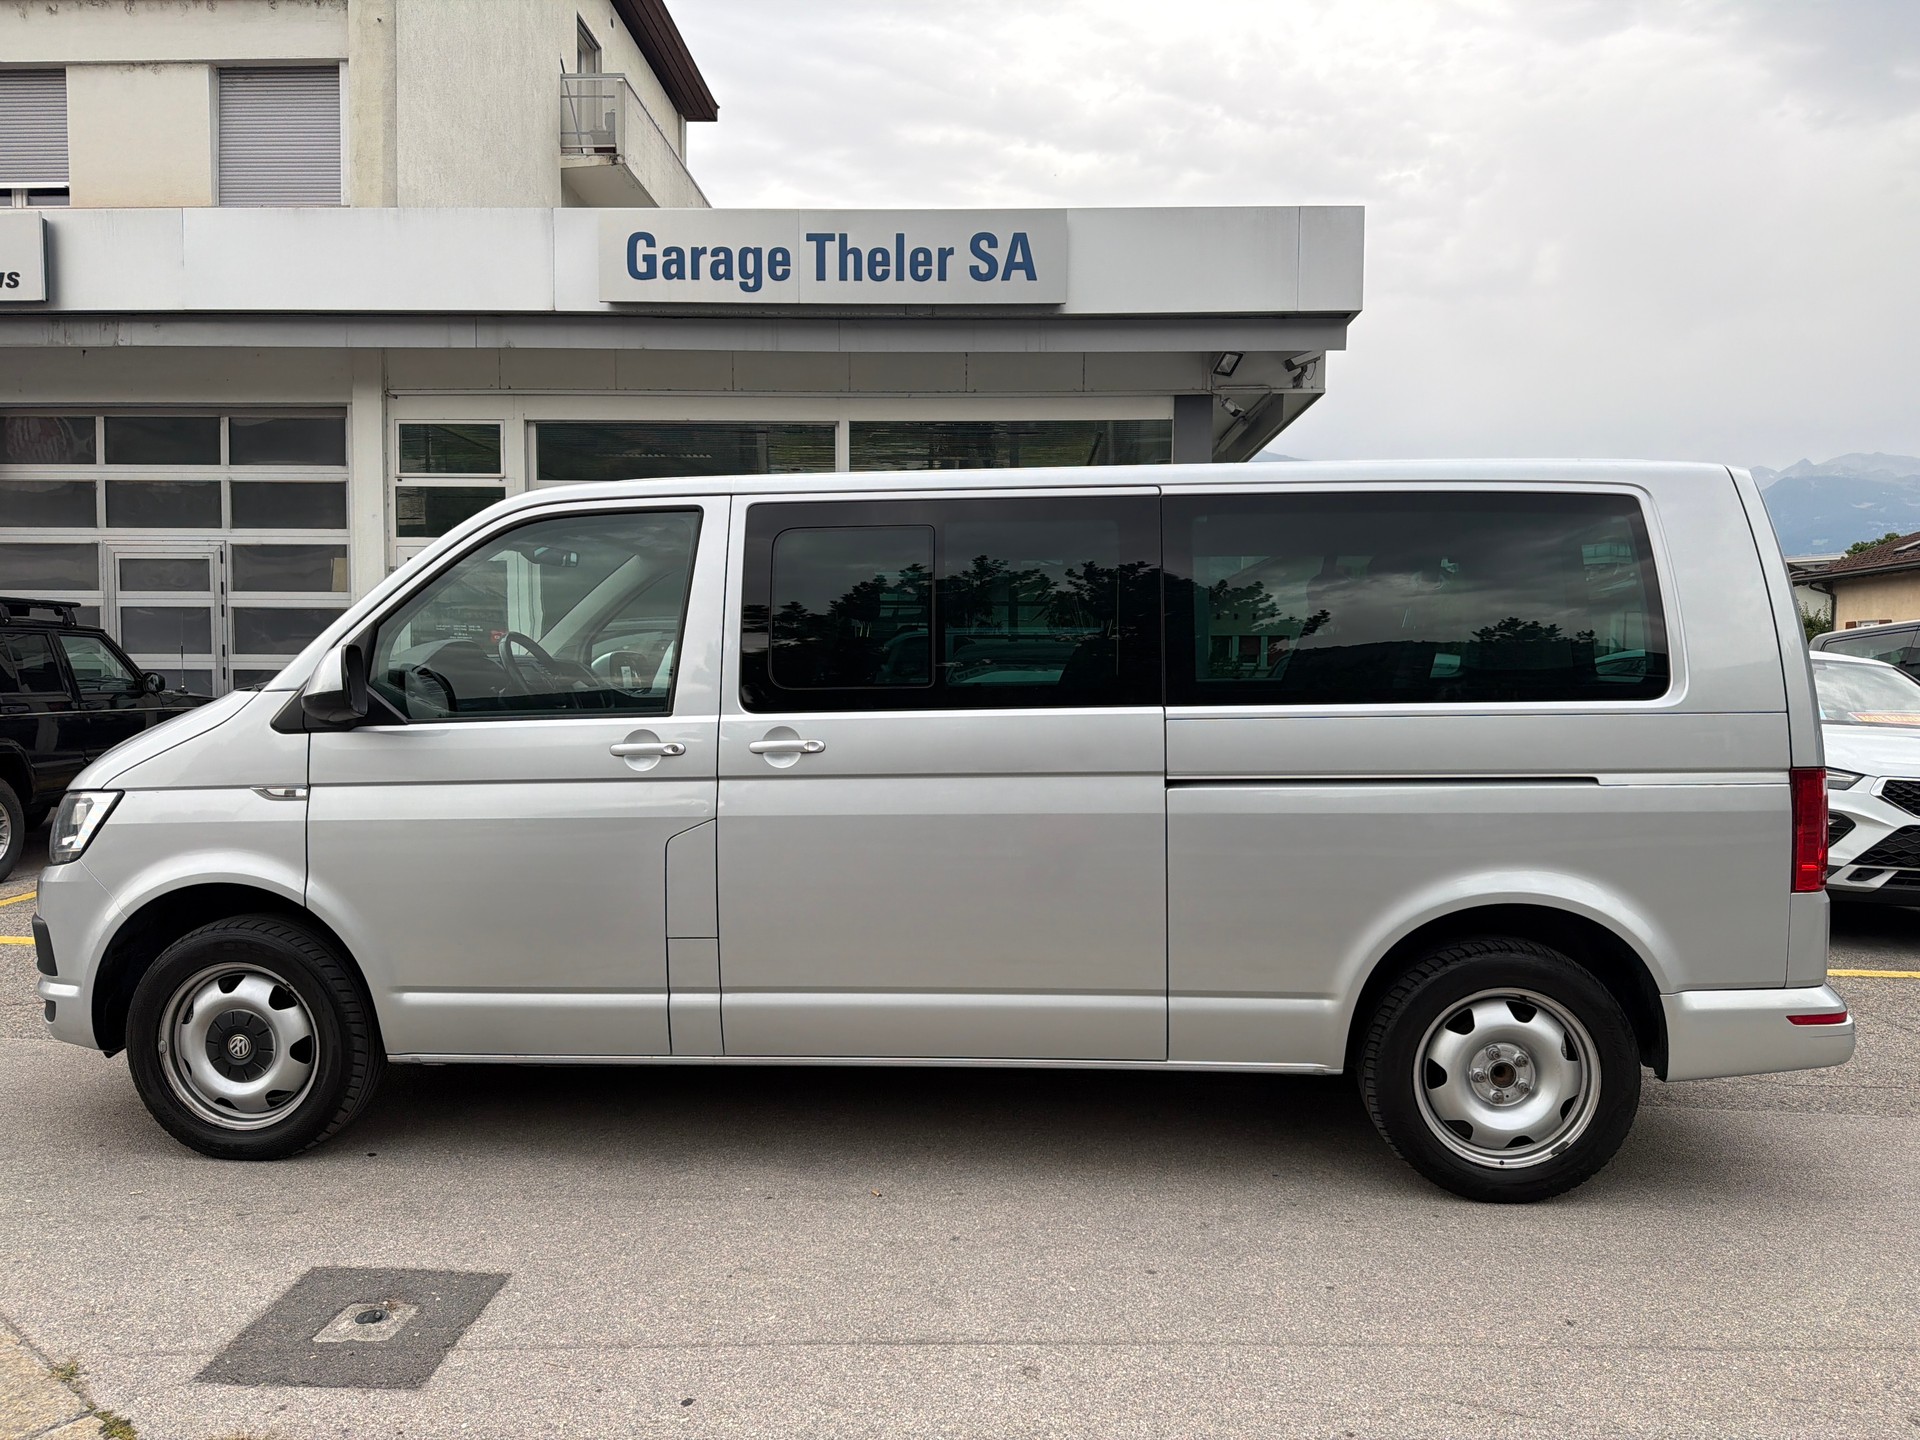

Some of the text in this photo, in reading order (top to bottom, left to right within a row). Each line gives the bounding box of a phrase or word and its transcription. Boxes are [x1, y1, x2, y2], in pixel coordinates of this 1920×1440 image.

[626, 231, 1038, 292] Garage Theler SA
